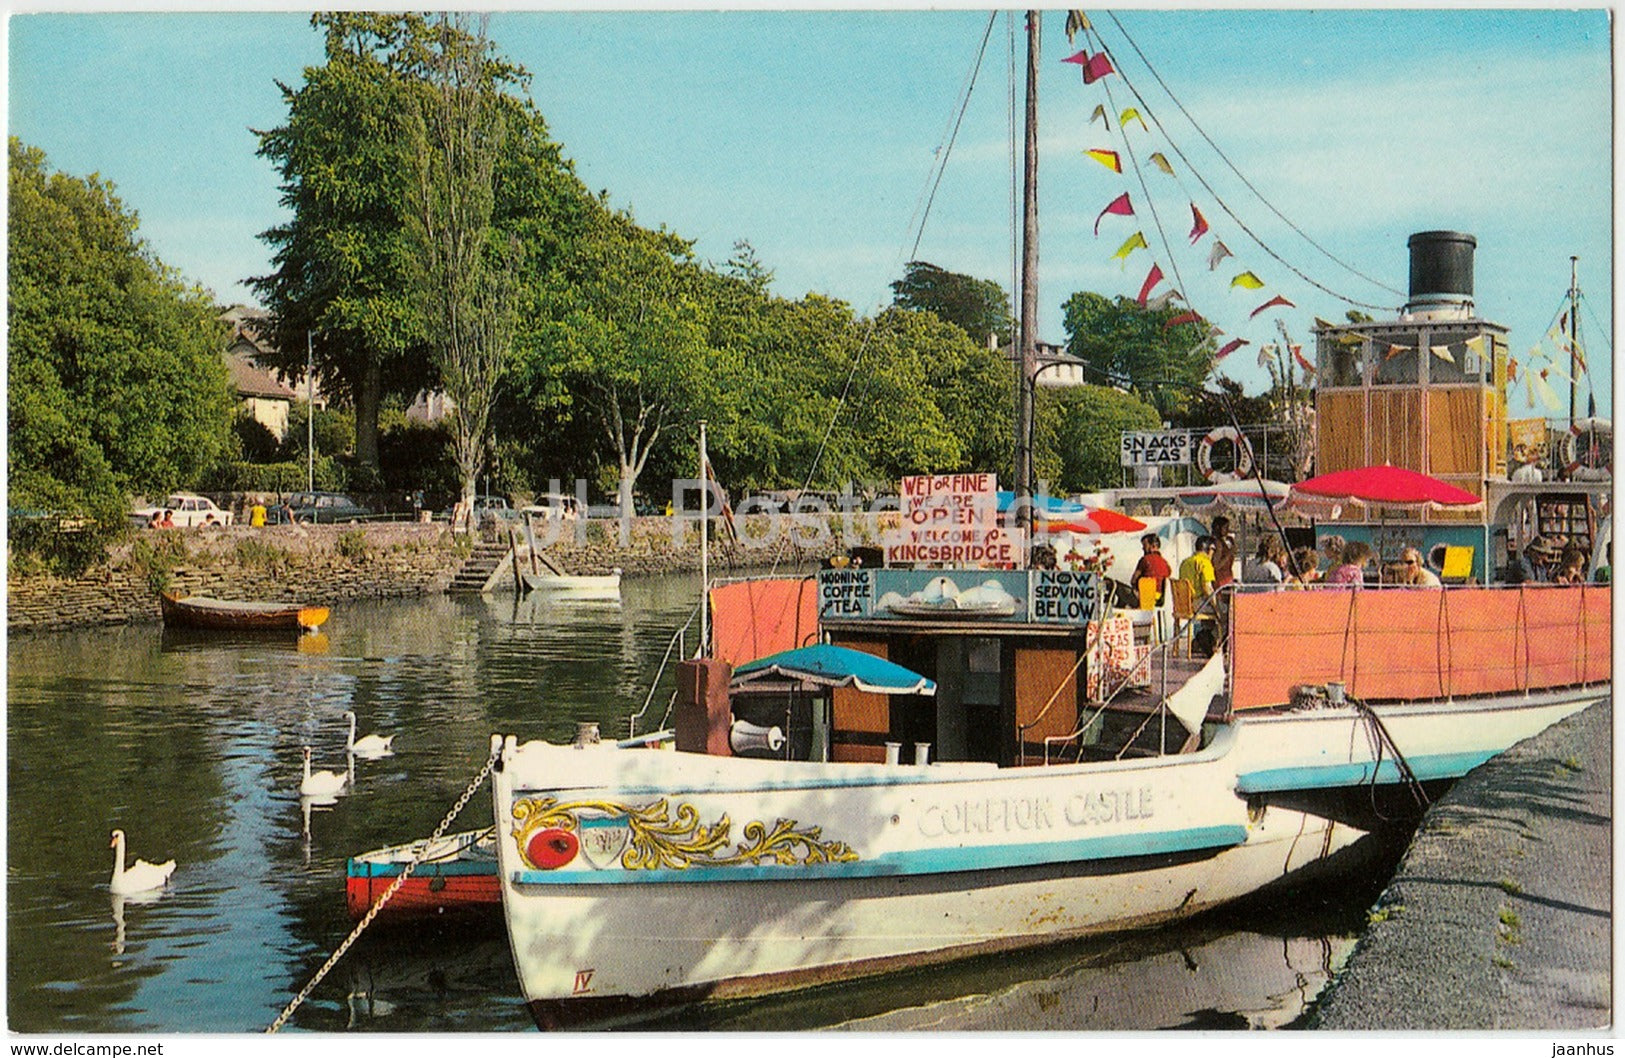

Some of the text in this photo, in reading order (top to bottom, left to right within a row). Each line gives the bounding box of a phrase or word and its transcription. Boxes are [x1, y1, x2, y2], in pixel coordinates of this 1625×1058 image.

[1123, 436, 1187, 450] SNACKS
[1130, 449, 1180, 462] TEAS
[904, 476, 933, 496] WET
[952, 475, 988, 493] FINE
[912, 494, 974, 508] WE ARE
[912, 508, 984, 525] OPEN
[911, 530, 981, 543] WELCOME
[888, 545, 1011, 561] KINGSBRIDGE
[821, 572, 869, 585] MORNING
[1041, 571, 1092, 585] NOW
[823, 585, 871, 598] COFFEE
[1035, 585, 1095, 600] SERVING
[833, 599, 863, 613] TEA
[1035, 600, 1095, 620] BELOW
[1063, 784, 1155, 827] CASTLE
